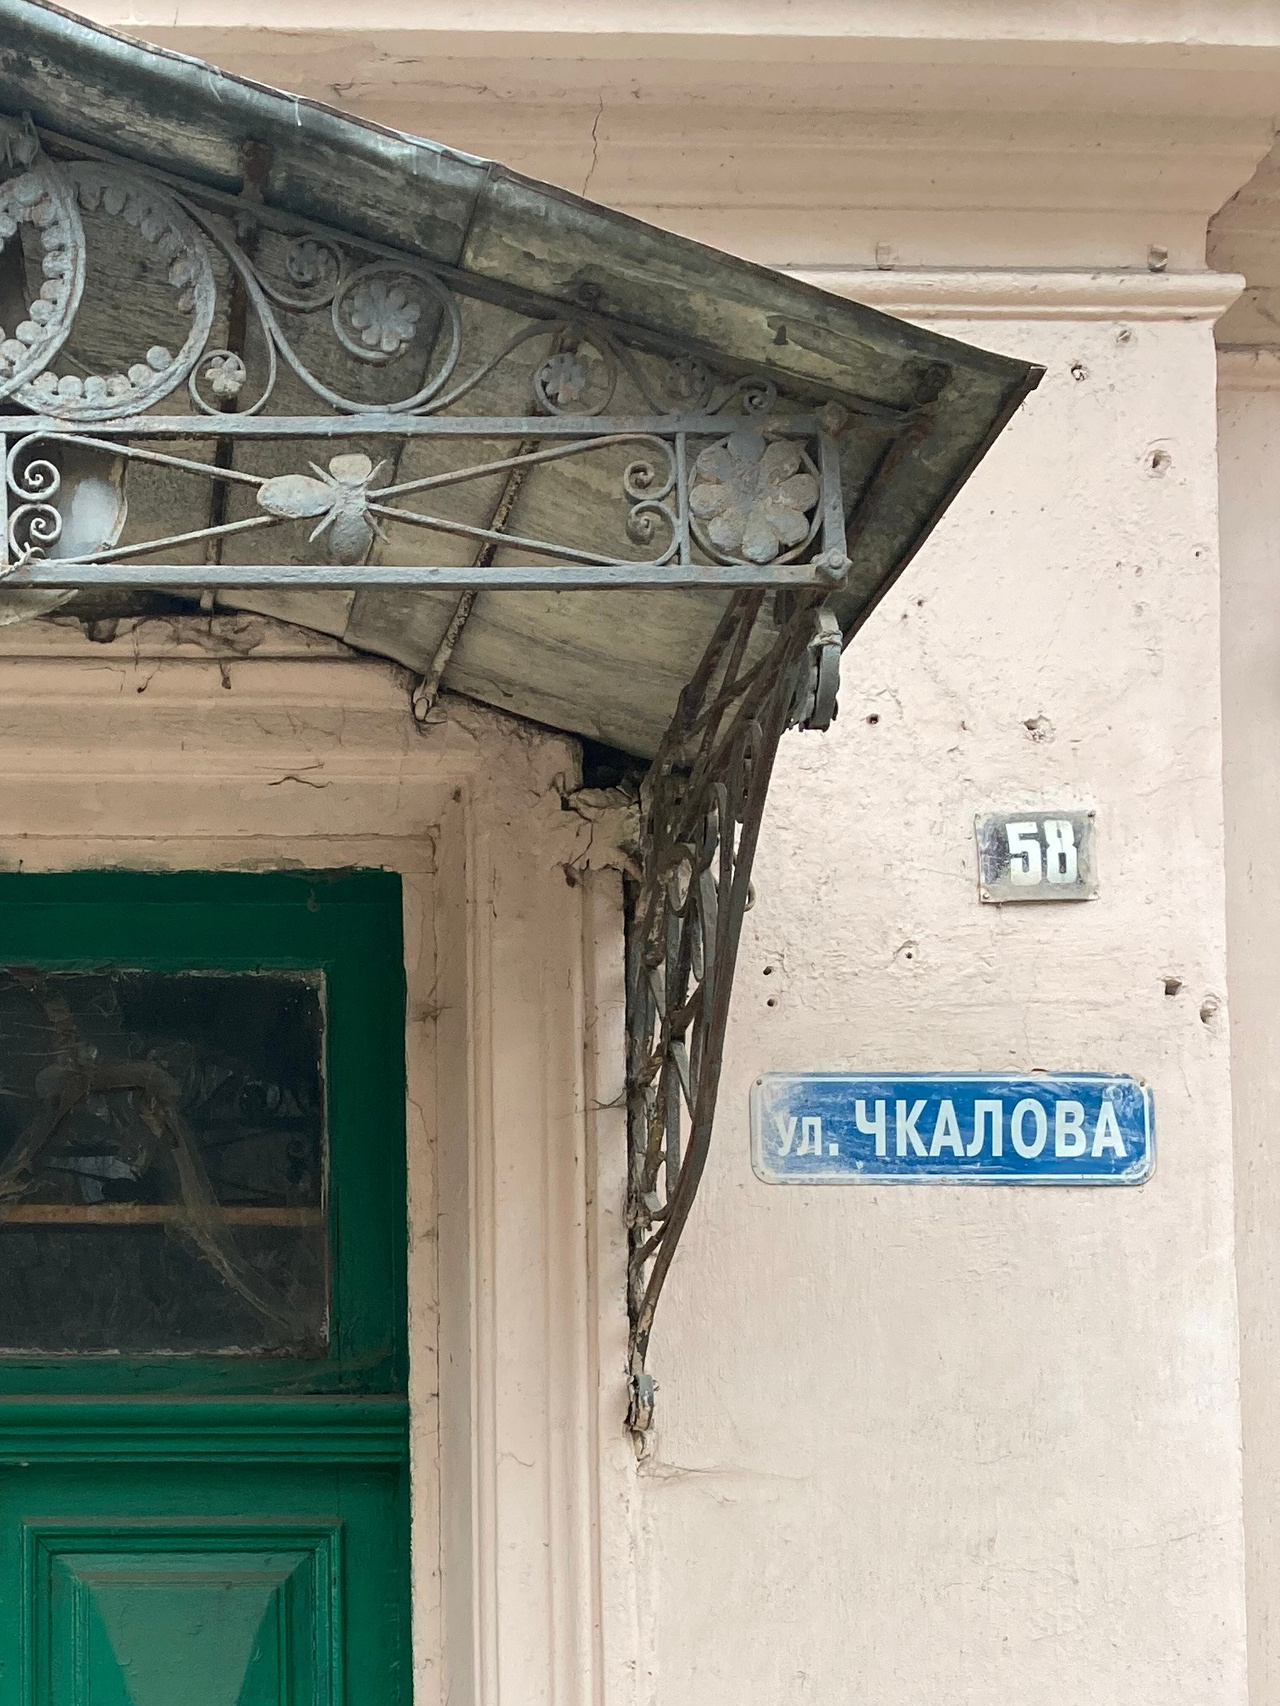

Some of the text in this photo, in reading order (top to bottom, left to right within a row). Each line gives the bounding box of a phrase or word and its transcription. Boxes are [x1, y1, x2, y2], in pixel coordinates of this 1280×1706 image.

[1005, 820, 1078, 885] 58
[775, 1098, 1128, 1158] ул. ЧКАЛОВА
